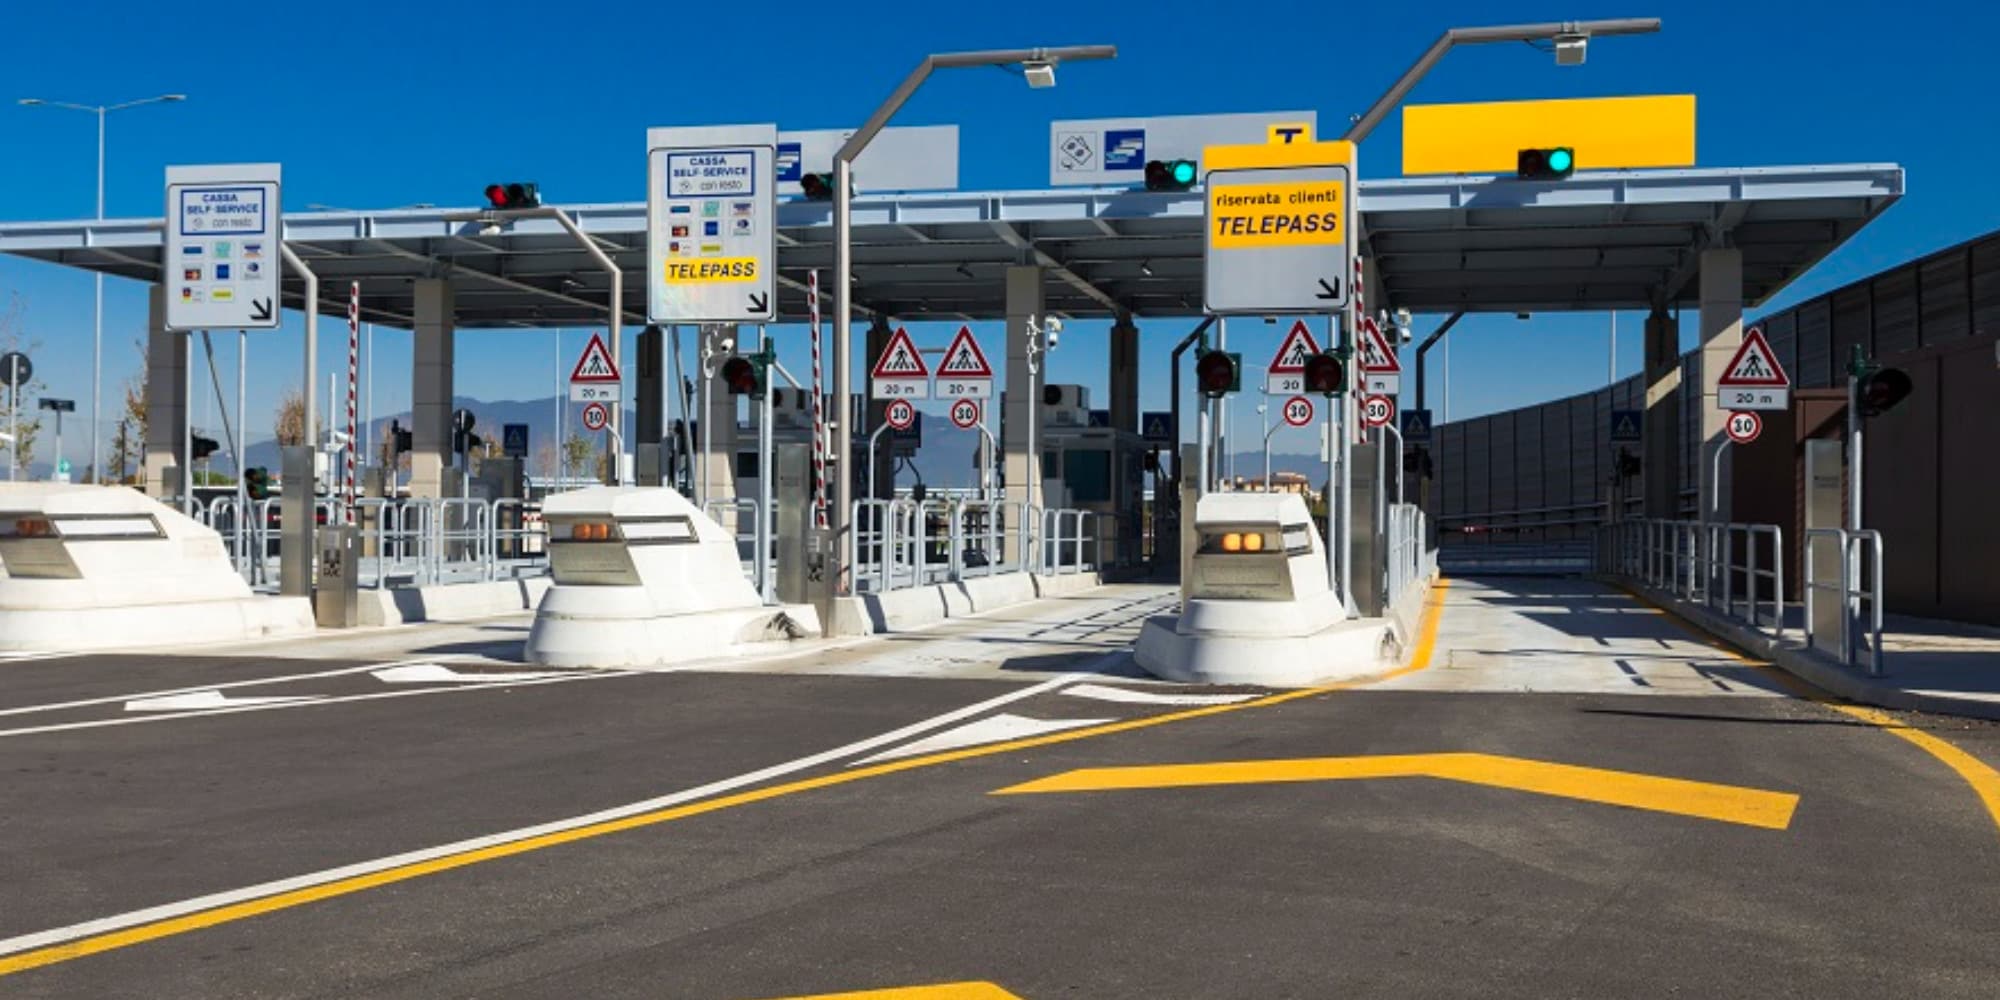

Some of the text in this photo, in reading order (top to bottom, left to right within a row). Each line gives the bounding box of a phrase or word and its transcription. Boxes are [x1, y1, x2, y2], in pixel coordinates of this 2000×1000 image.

[1275, 128, 1303, 144] T
[689, 157, 727, 166] CASSA
[701, 180, 743, 191] con resto
[202, 193, 238, 202] CASSA
[1216, 190, 1336, 206] riservata clienti
[212, 218, 252, 228] con resto
[1217, 212, 1337, 236] TELEPASS
[669, 262, 755, 279] TELEPASS
[582, 388, 596, 398] 20
[884, 384, 914, 394] 20 m
[949, 384, 978, 394] 20 m
[1736, 392, 1773, 403] 20 m
[957, 407, 973, 419] 30
[1289, 404, 1308, 418] 30
[1368, 404, 1386, 417] 30
[1735, 418, 1753, 433] 30
